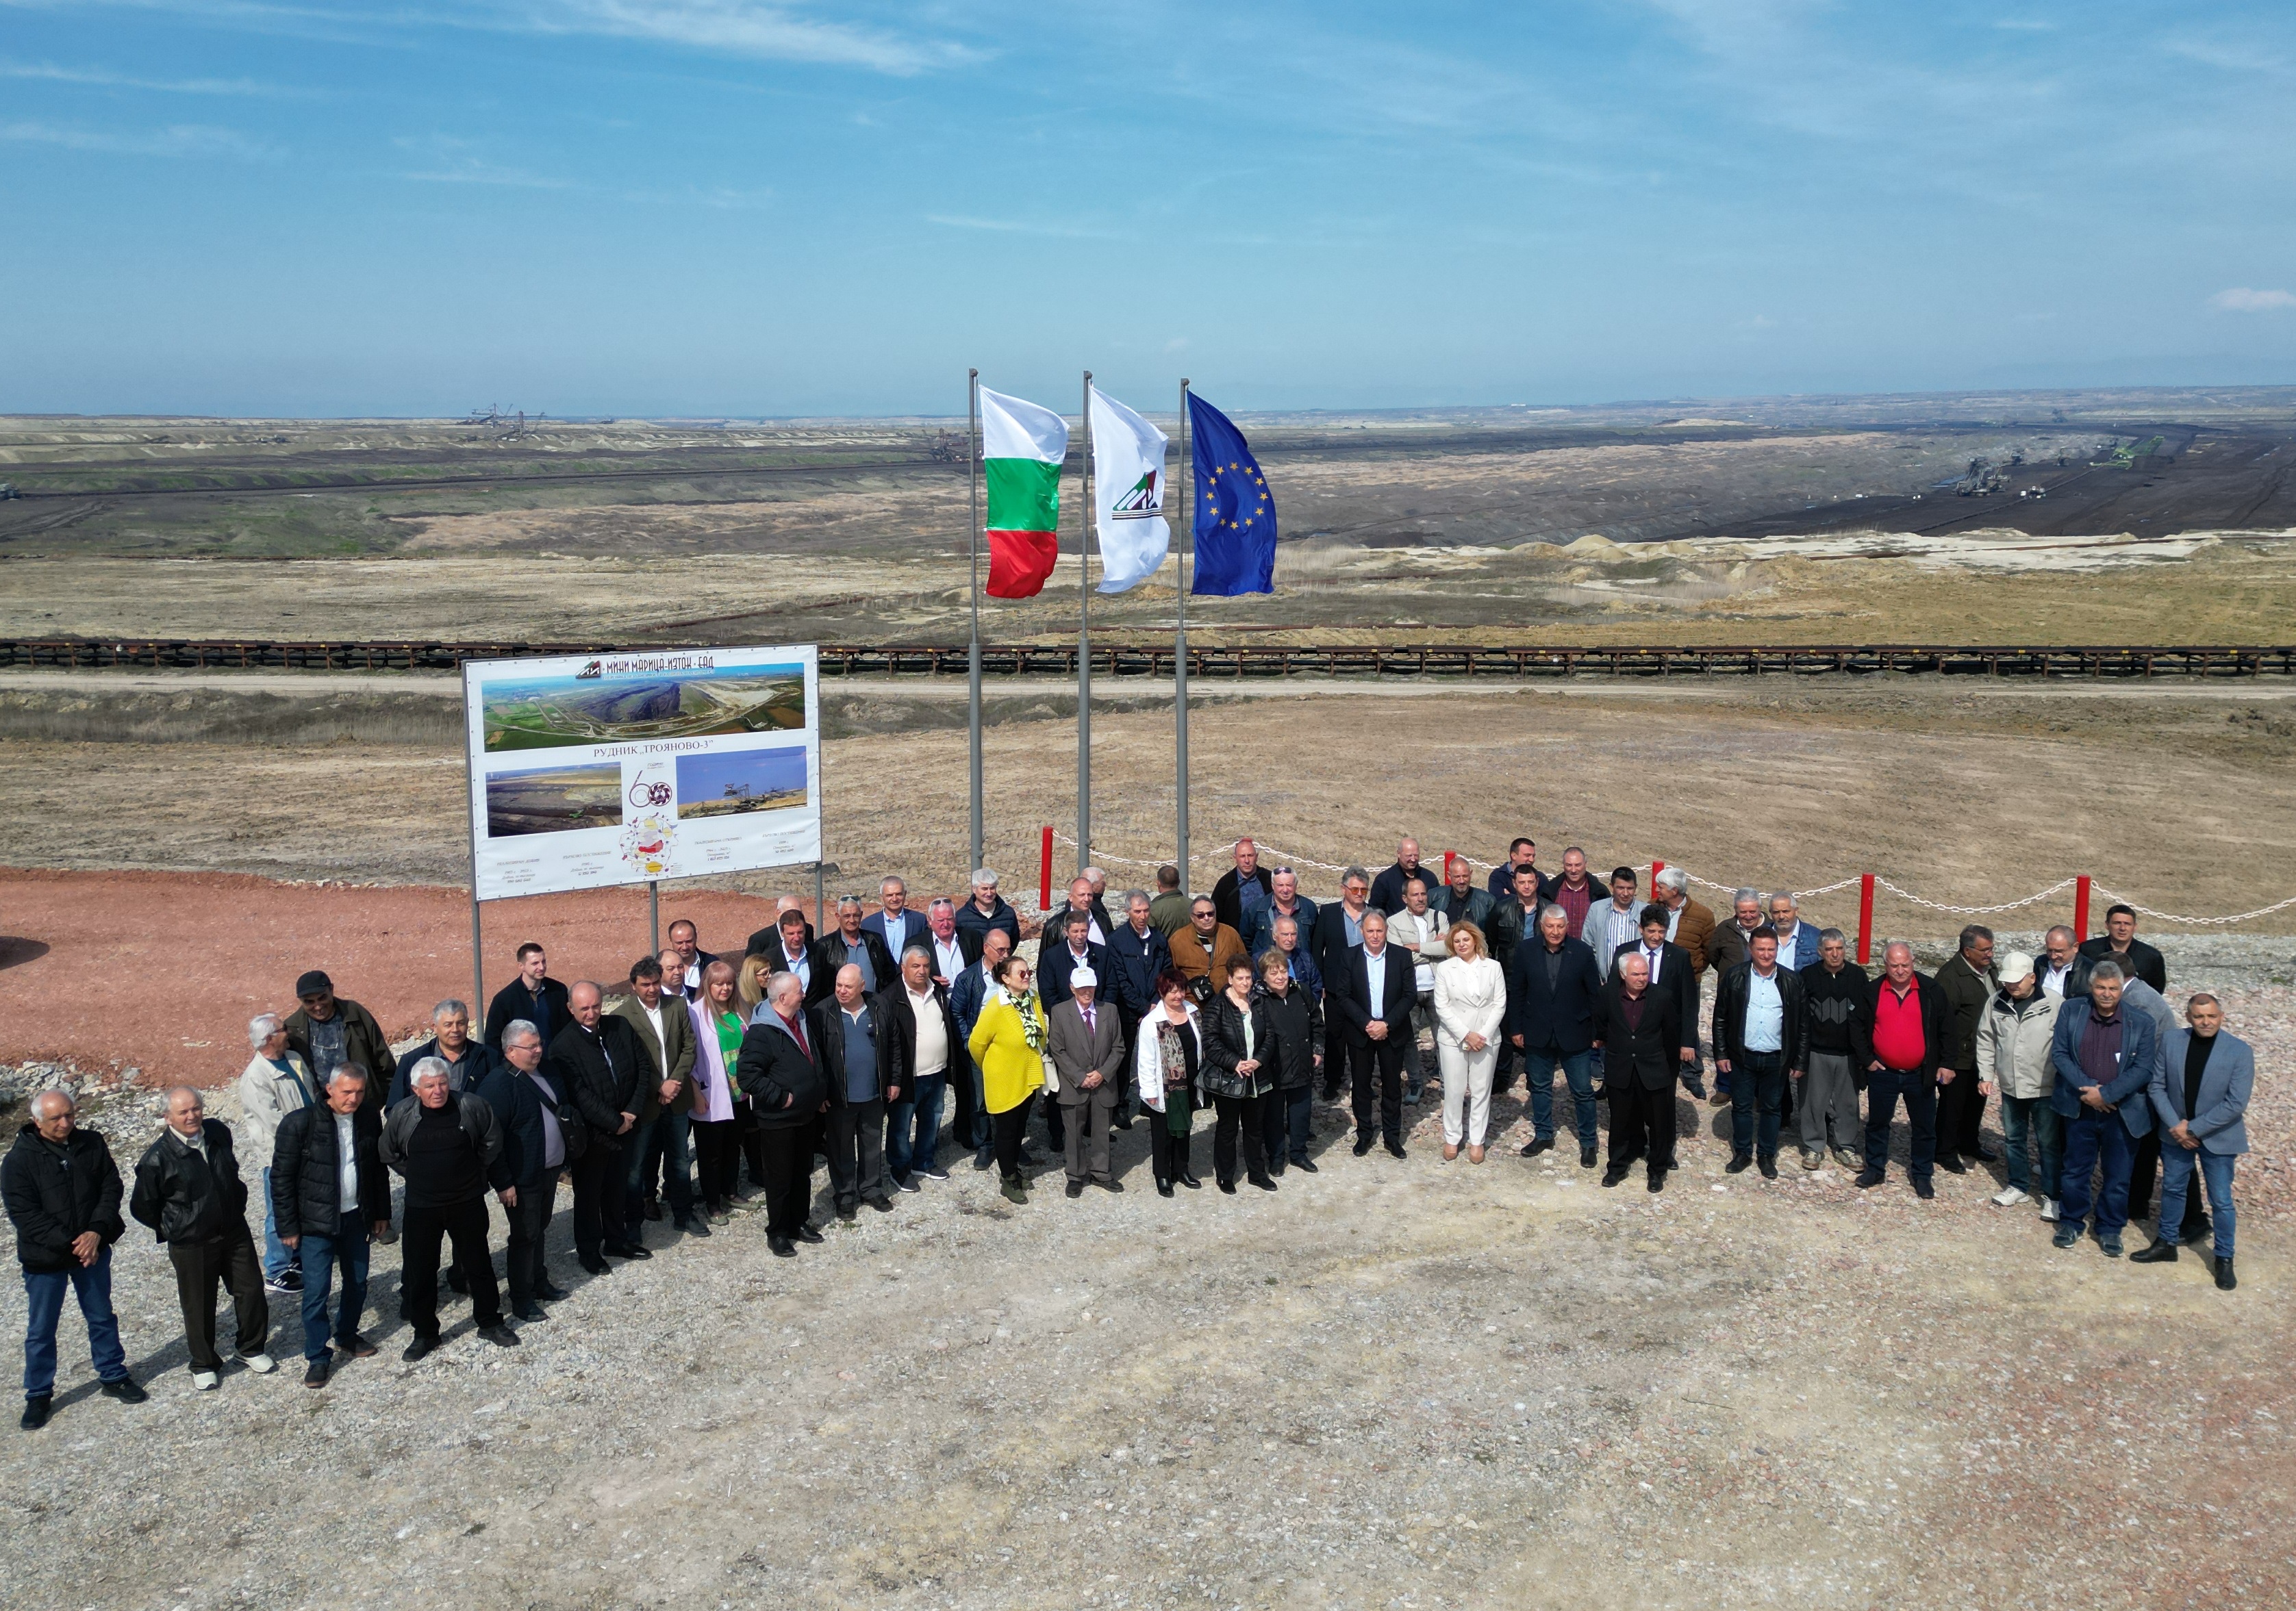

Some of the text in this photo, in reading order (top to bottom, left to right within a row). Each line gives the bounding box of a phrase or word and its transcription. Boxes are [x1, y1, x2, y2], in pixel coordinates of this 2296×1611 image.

[606, 656, 714, 674] МИНИ МАРИЦА-ИЗТОК ЕАД
[594, 746, 638, 758] РУДНИК
